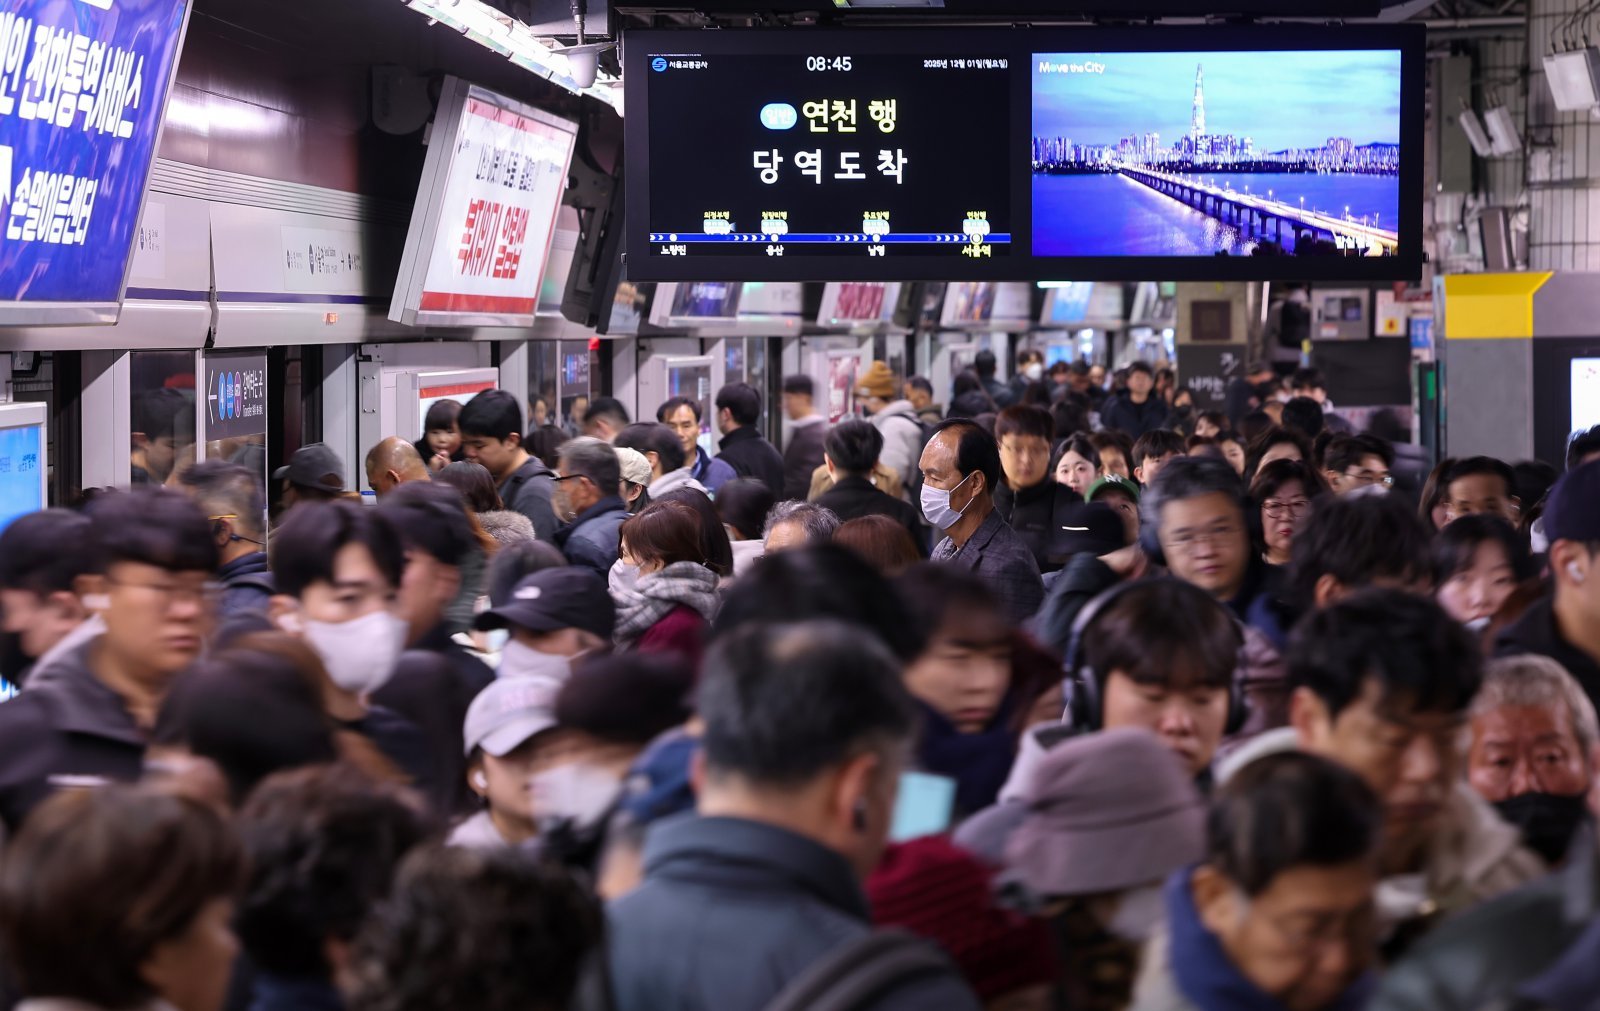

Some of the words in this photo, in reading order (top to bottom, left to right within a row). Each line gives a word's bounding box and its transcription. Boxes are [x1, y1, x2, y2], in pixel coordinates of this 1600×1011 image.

[669, 60, 708, 69] 서울교통공사
[806, 56, 852, 71] 08:45
[923, 59, 948, 69] 2025년
[950, 59, 965, 69] 12월
[966, 59, 1008, 69] 01일(월요일)
[1039, 61, 1069, 73] Move
[1070, 63, 1084, 73] the
[1084, 61, 1106, 75] City
[18, 24, 145, 139] 전화통역서비스
[765, 108, 793, 126] 일반
[802, 99, 857, 133] 연천
[868, 99, 897, 133] 행
[6, 166, 99, 246] 손말이음센터
[703, 210, 730, 220] 의정부행
[761, 210, 788, 220] 청량리행
[967, 210, 987, 220] 연천행
[457, 197, 504, 278] 복지위기
[660, 244, 686, 256] 노량진
[765, 244, 785, 256] 용산
[867, 244, 886, 257] 남영
[961, 244, 991, 258] 서울역
